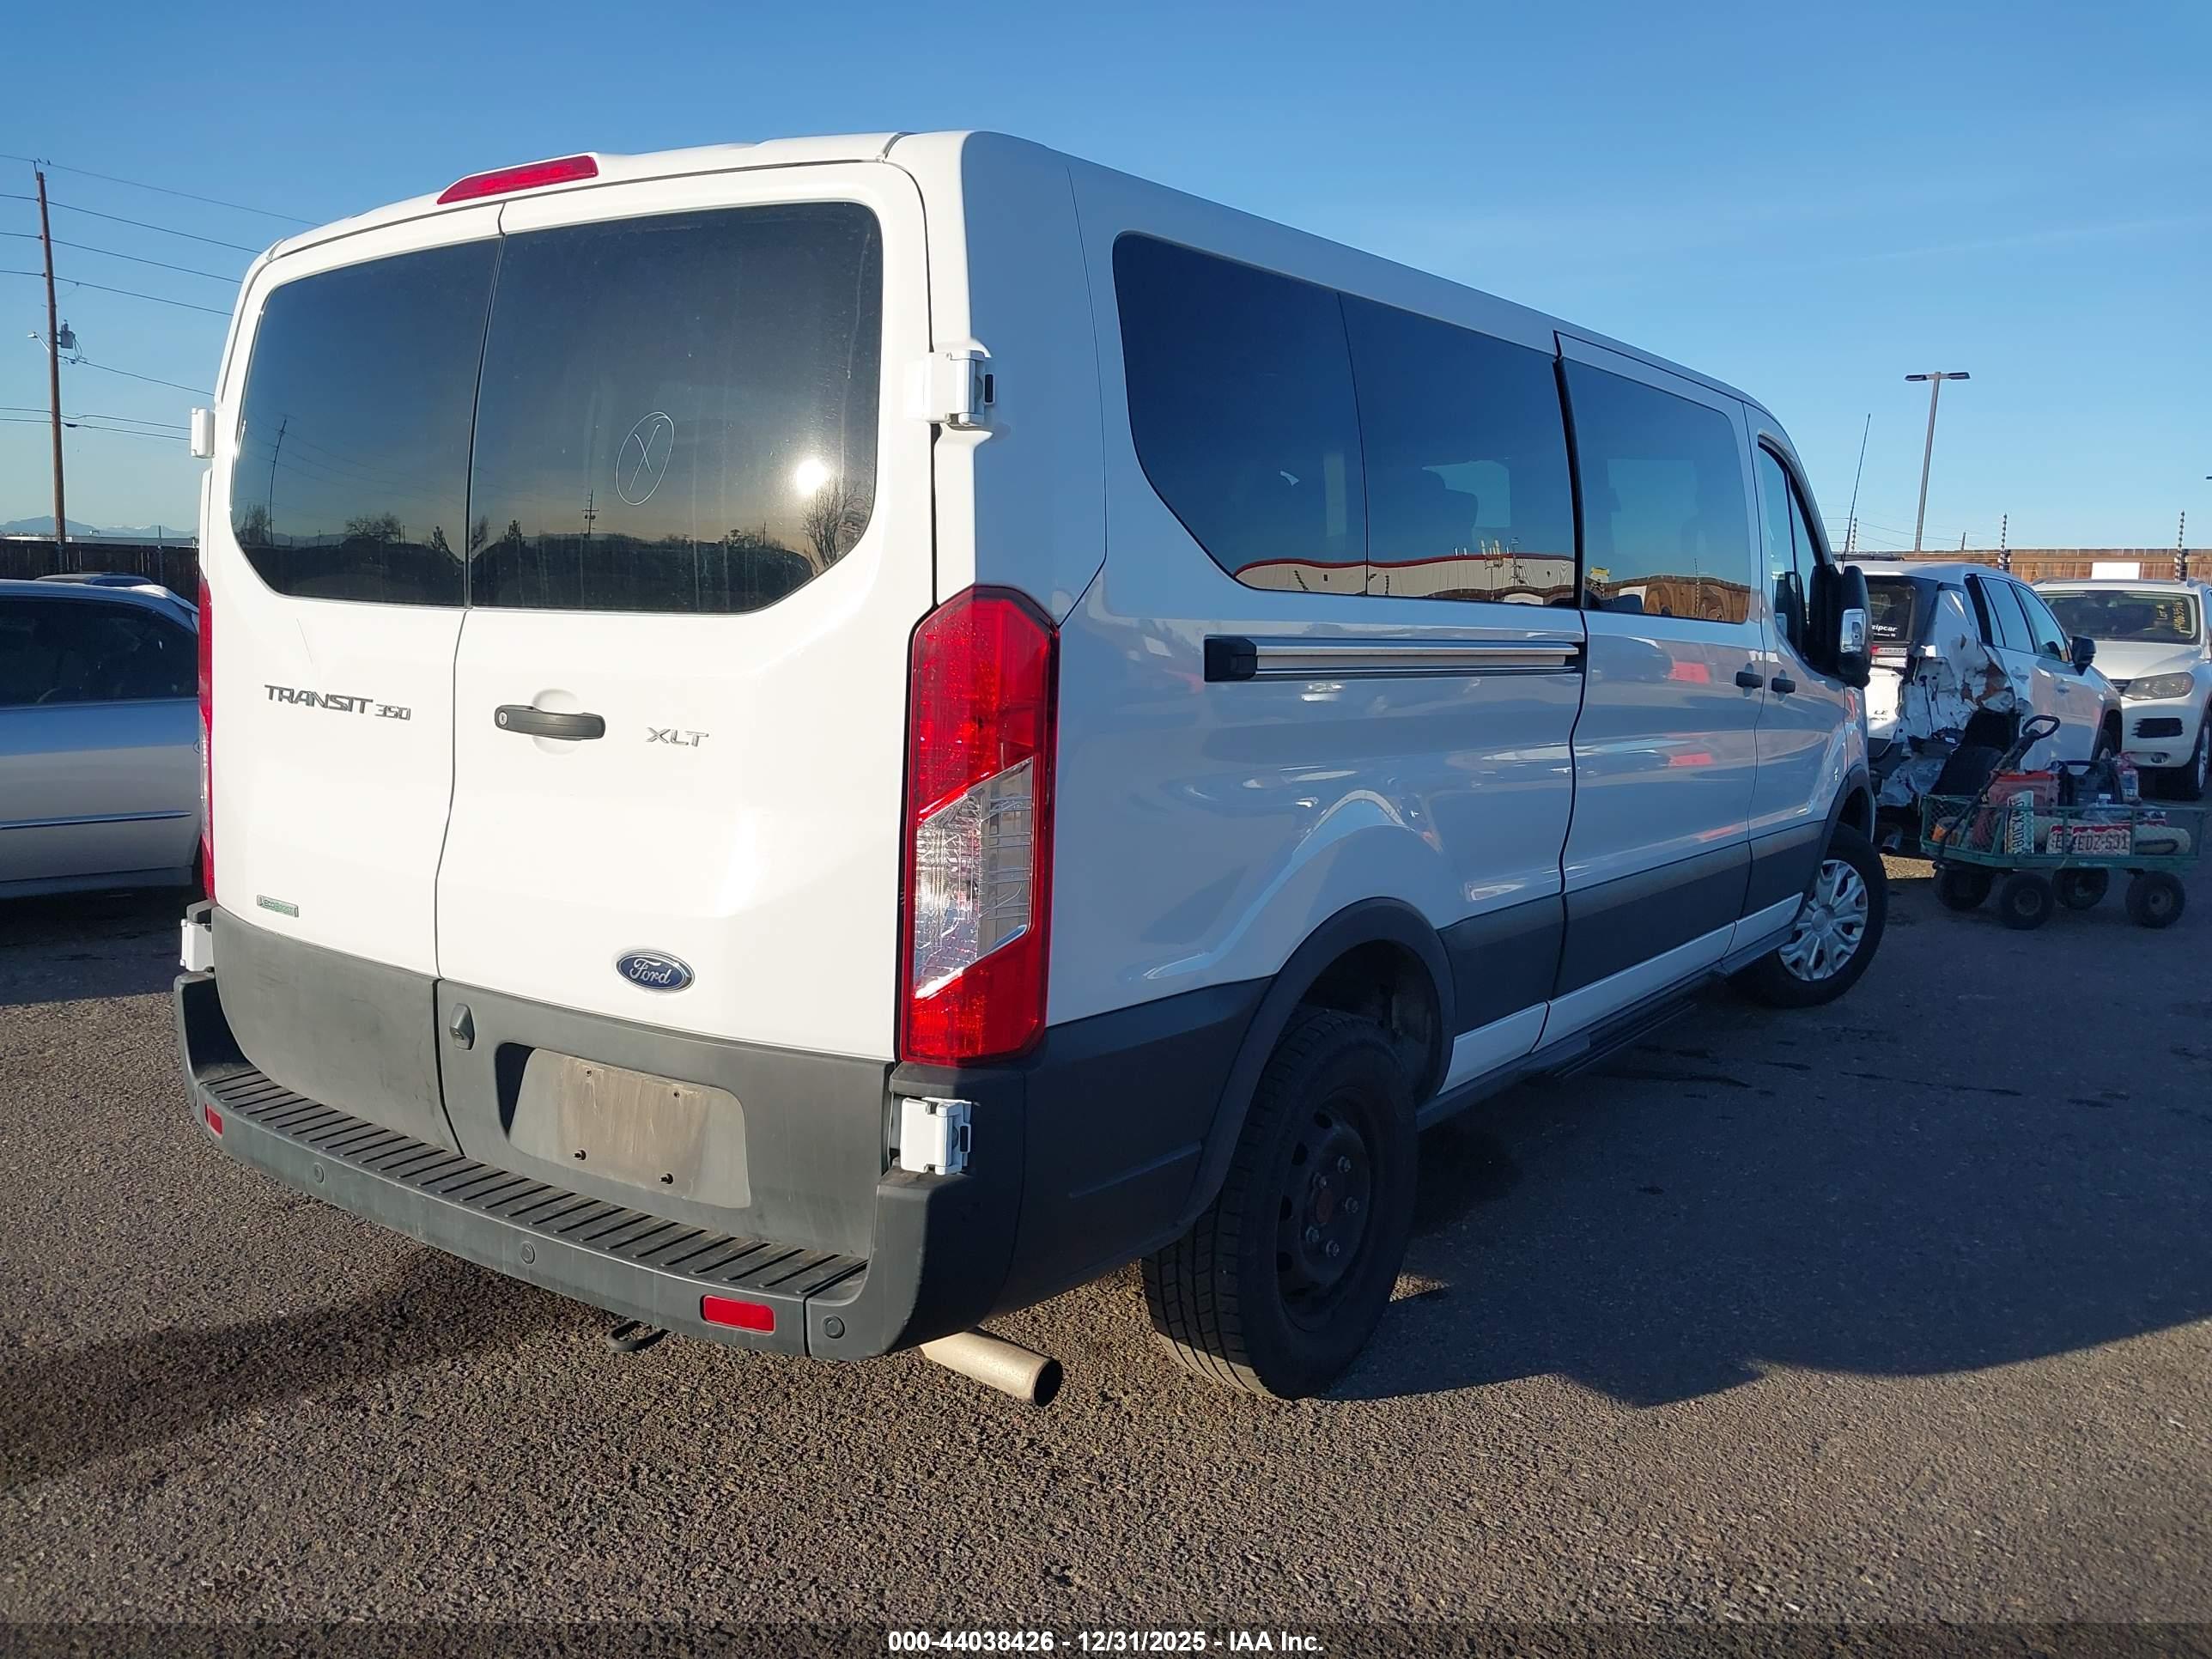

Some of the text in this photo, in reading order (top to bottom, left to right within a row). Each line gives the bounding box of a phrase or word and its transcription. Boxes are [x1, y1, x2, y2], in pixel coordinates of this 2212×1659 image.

[1872, 623, 1898, 632] zipcar
[264, 684, 411, 721] TRANSIT 350
[646, 726, 709, 747] XLT
[629, 957, 672, 986] Ford
